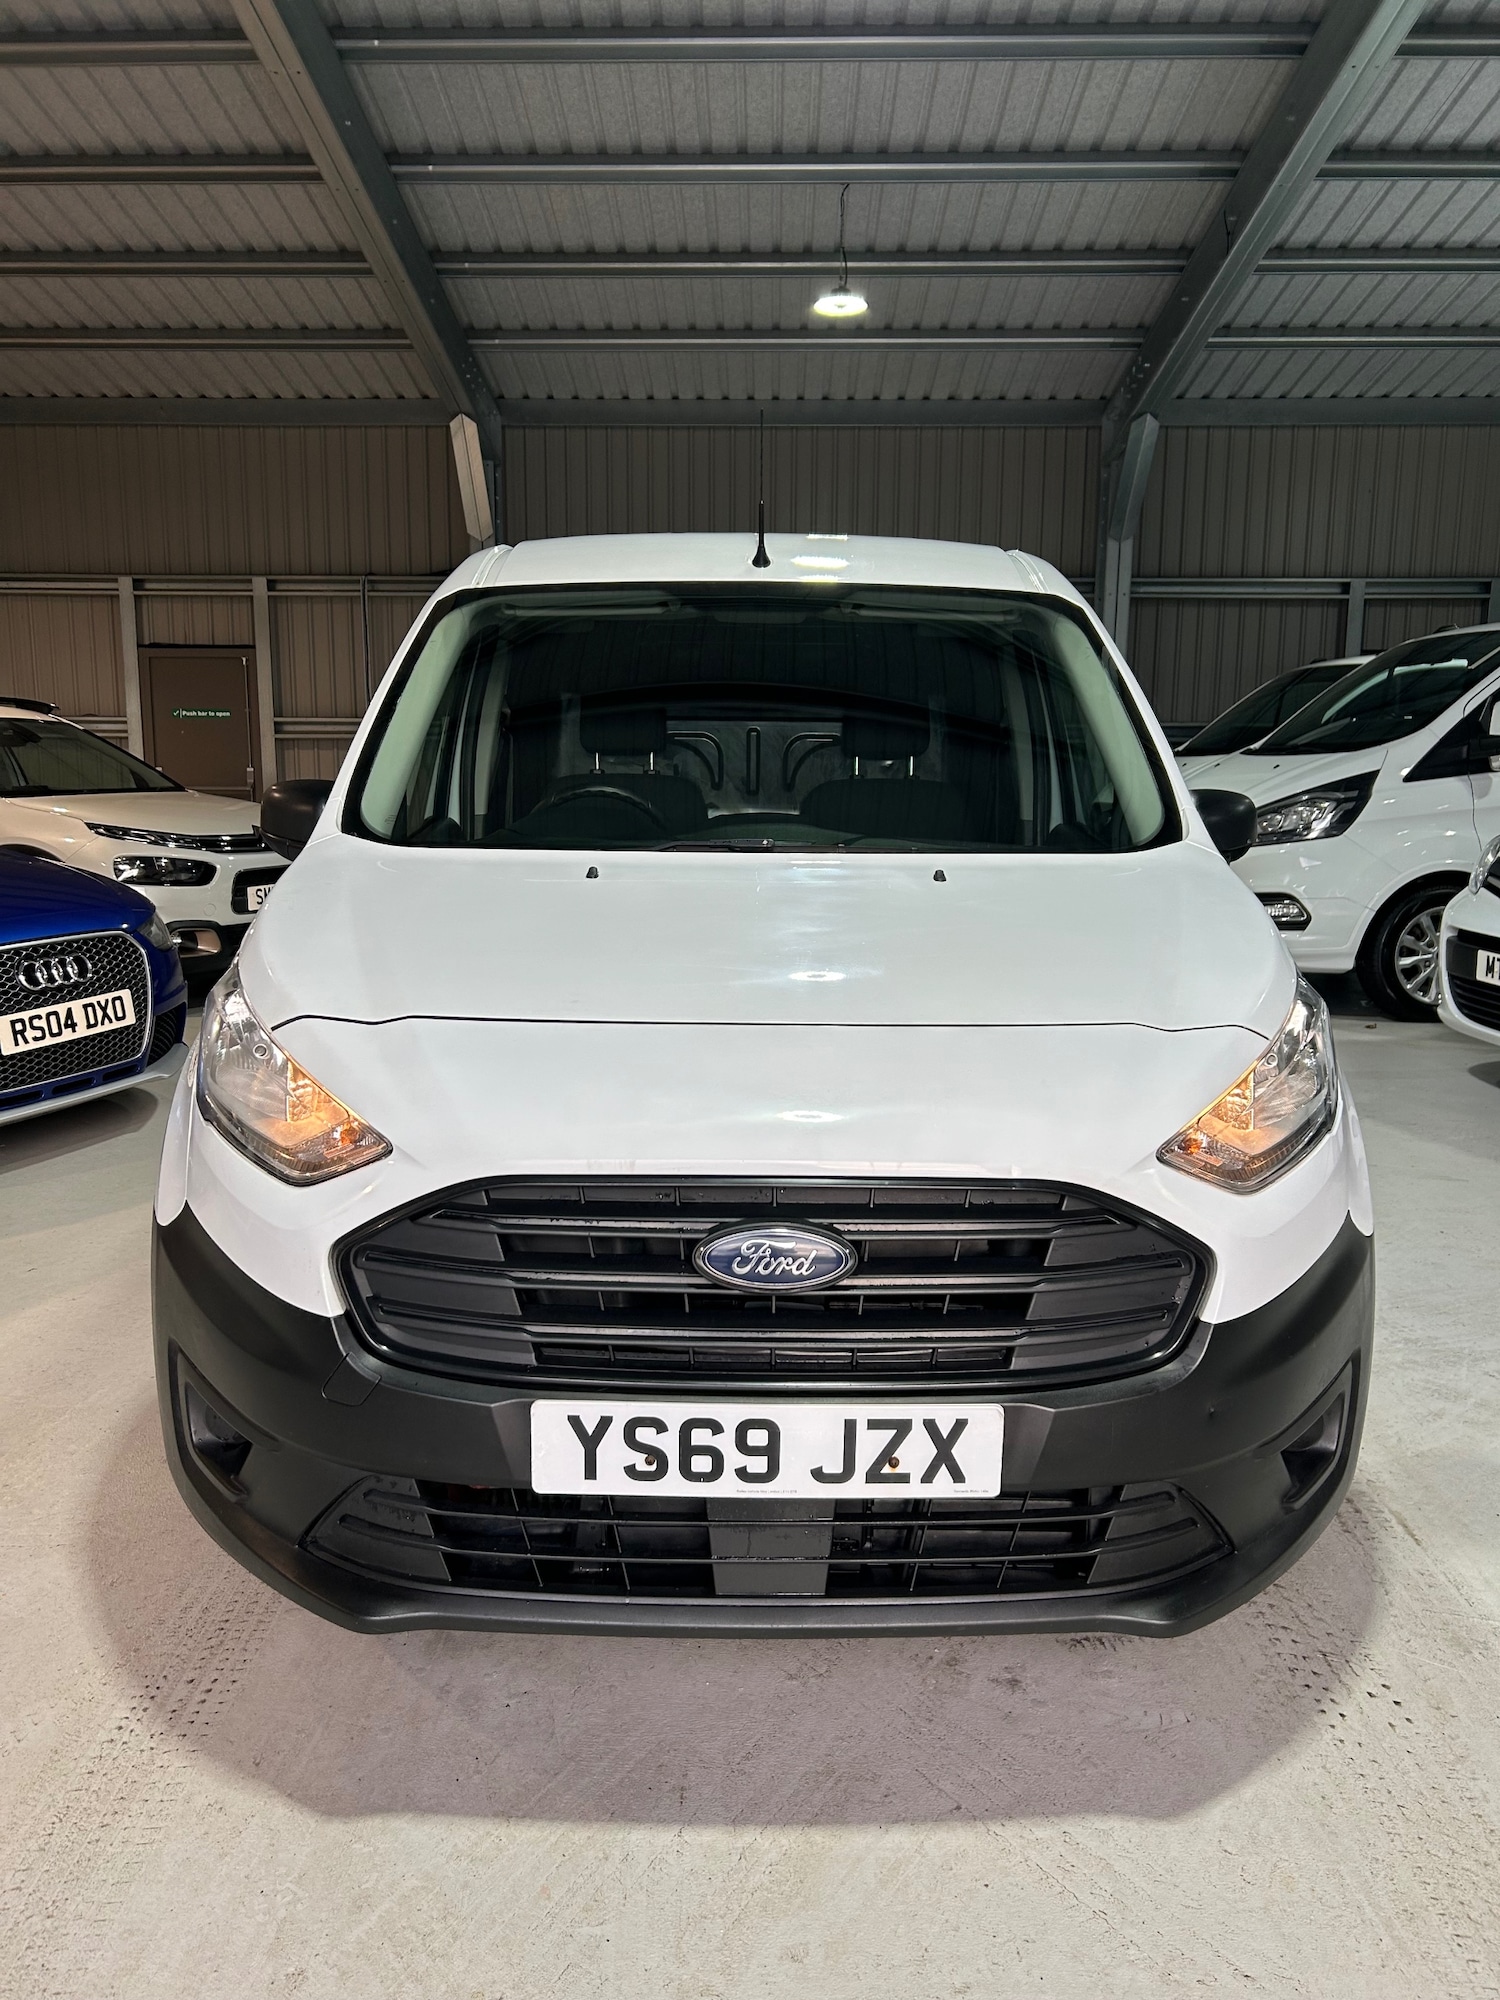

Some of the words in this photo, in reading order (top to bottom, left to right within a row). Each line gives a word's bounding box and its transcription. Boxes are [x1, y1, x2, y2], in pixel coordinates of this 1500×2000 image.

[10, 1007, 78, 1047] RS04
[82, 995, 126, 1030] DXO
[732, 1239, 818, 1276] Ford
[567, 1415, 781, 1484] YS69
[810, 1418, 969, 1484] JZX
